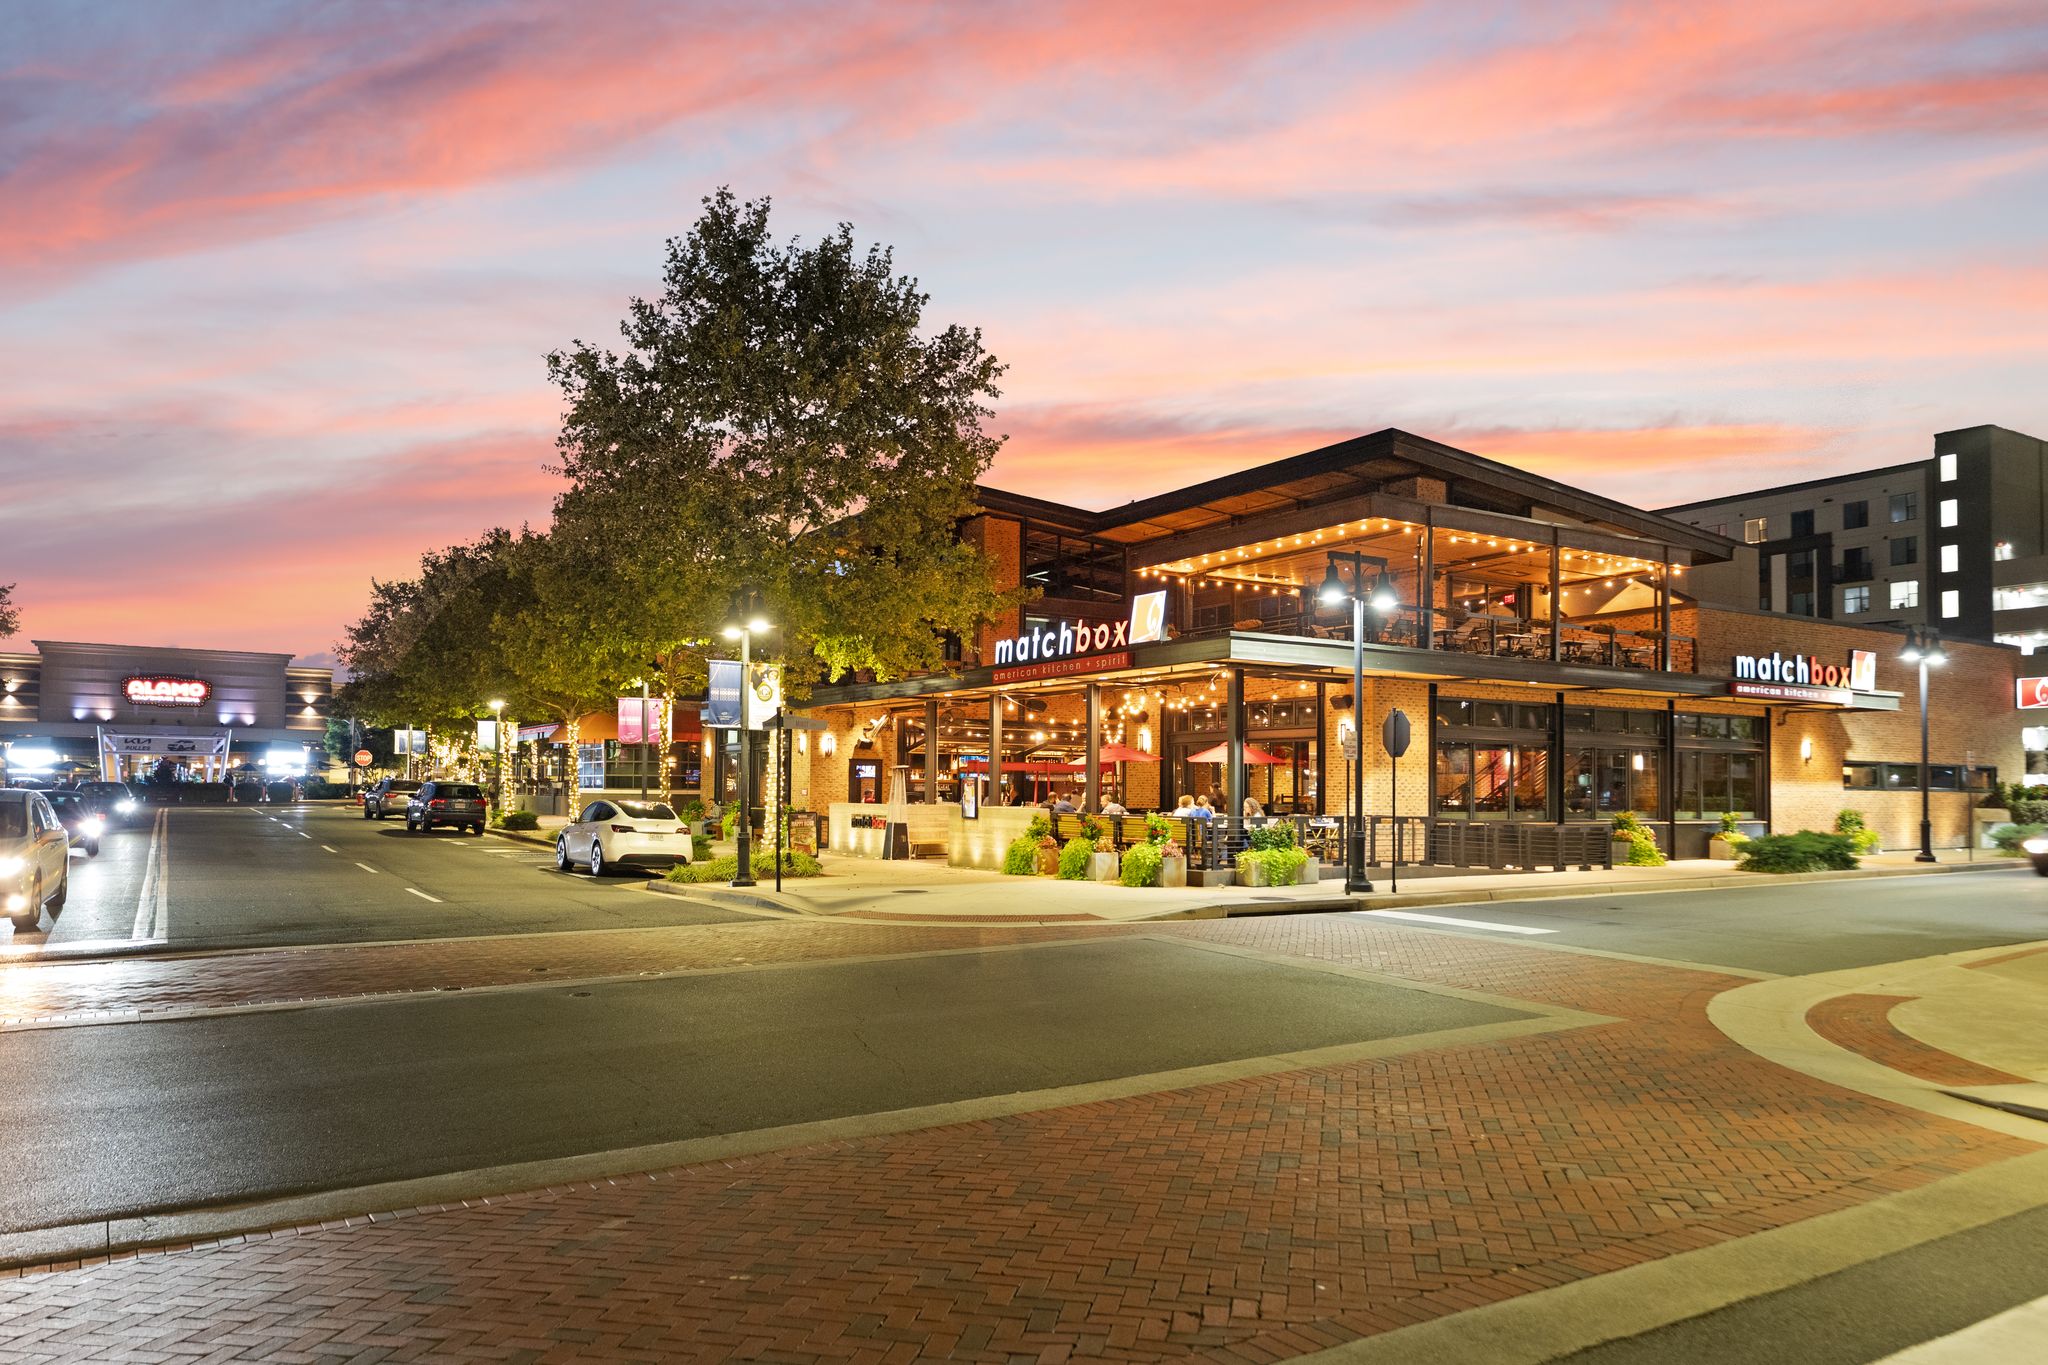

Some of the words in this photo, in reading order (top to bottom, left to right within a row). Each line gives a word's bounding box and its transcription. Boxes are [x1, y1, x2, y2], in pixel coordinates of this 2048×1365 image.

[995, 619, 1128, 664] matchbox
[994, 668, 1037, 681] american
[1042, 662, 1081, 675] kitchen
[1096, 655, 1126, 670] spirit
[1736, 652, 1850, 688] matchbox
[127, 680, 205, 697] ALAMO
[1737, 685, 1781, 696] american
[1784, 690, 1819, 699] kitchen
